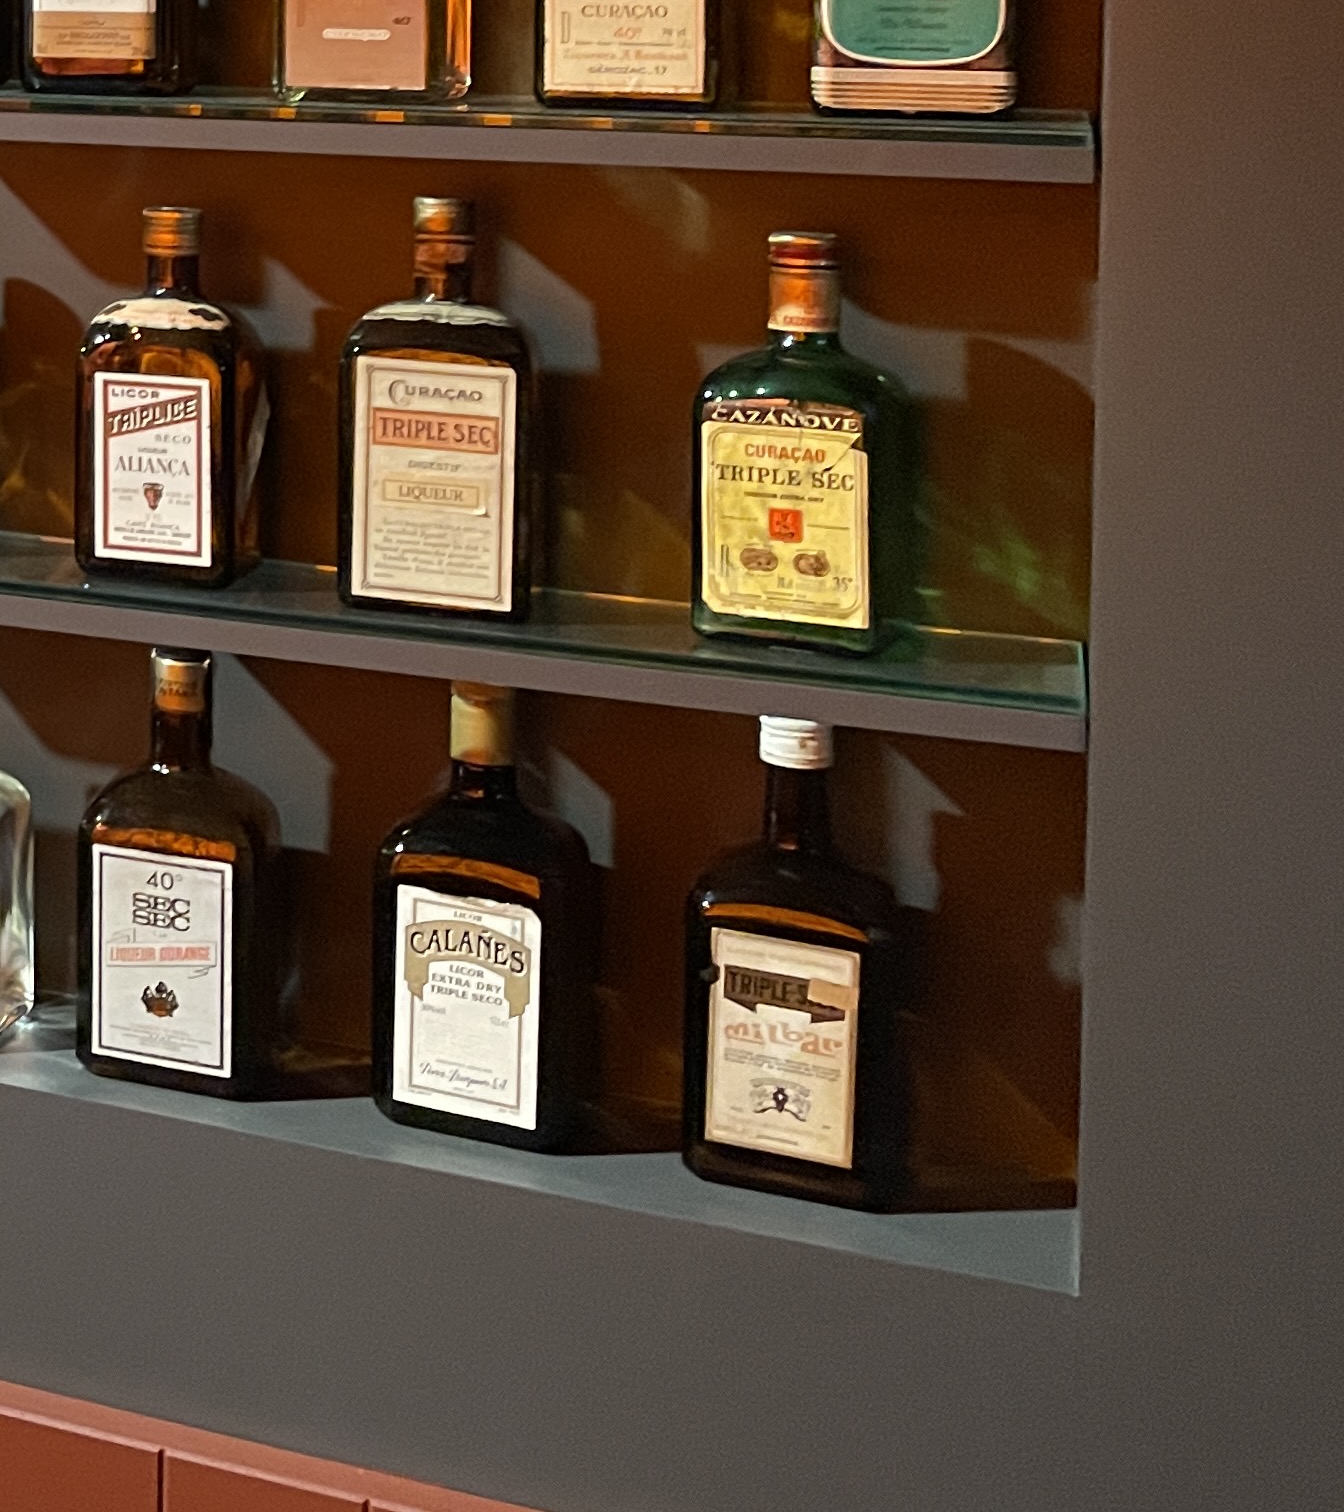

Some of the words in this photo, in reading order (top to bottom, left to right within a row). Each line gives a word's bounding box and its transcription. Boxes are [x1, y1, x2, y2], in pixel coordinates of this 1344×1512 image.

[581, 5, 669, 19] CURAÇAO
[111, 388, 161, 400] LICOR
[107, 399, 198, 436] TRIPLICE
[378, 417, 449, 443] TRIPLE
[453, 424, 493, 448] SEC
[744, 443, 827, 465] CURAÇAO
[114, 455, 191, 478] ALIANÇA
[717, 464, 802, 487] TRIPLE
[812, 474, 855, 492] SEC
[398, 484, 464, 503] LIQUEUR
[132, 892, 191, 914] SEC
[132, 910, 191, 932] SEC
[410, 929, 526, 974] CALAÑES
[449, 963, 484, 978] LICOR
[430, 972, 471, 988] EXTRA
[475, 981, 502, 995] DRY
[430, 983, 468, 999] TRIPLE
[471, 990, 503, 1006] SECO
